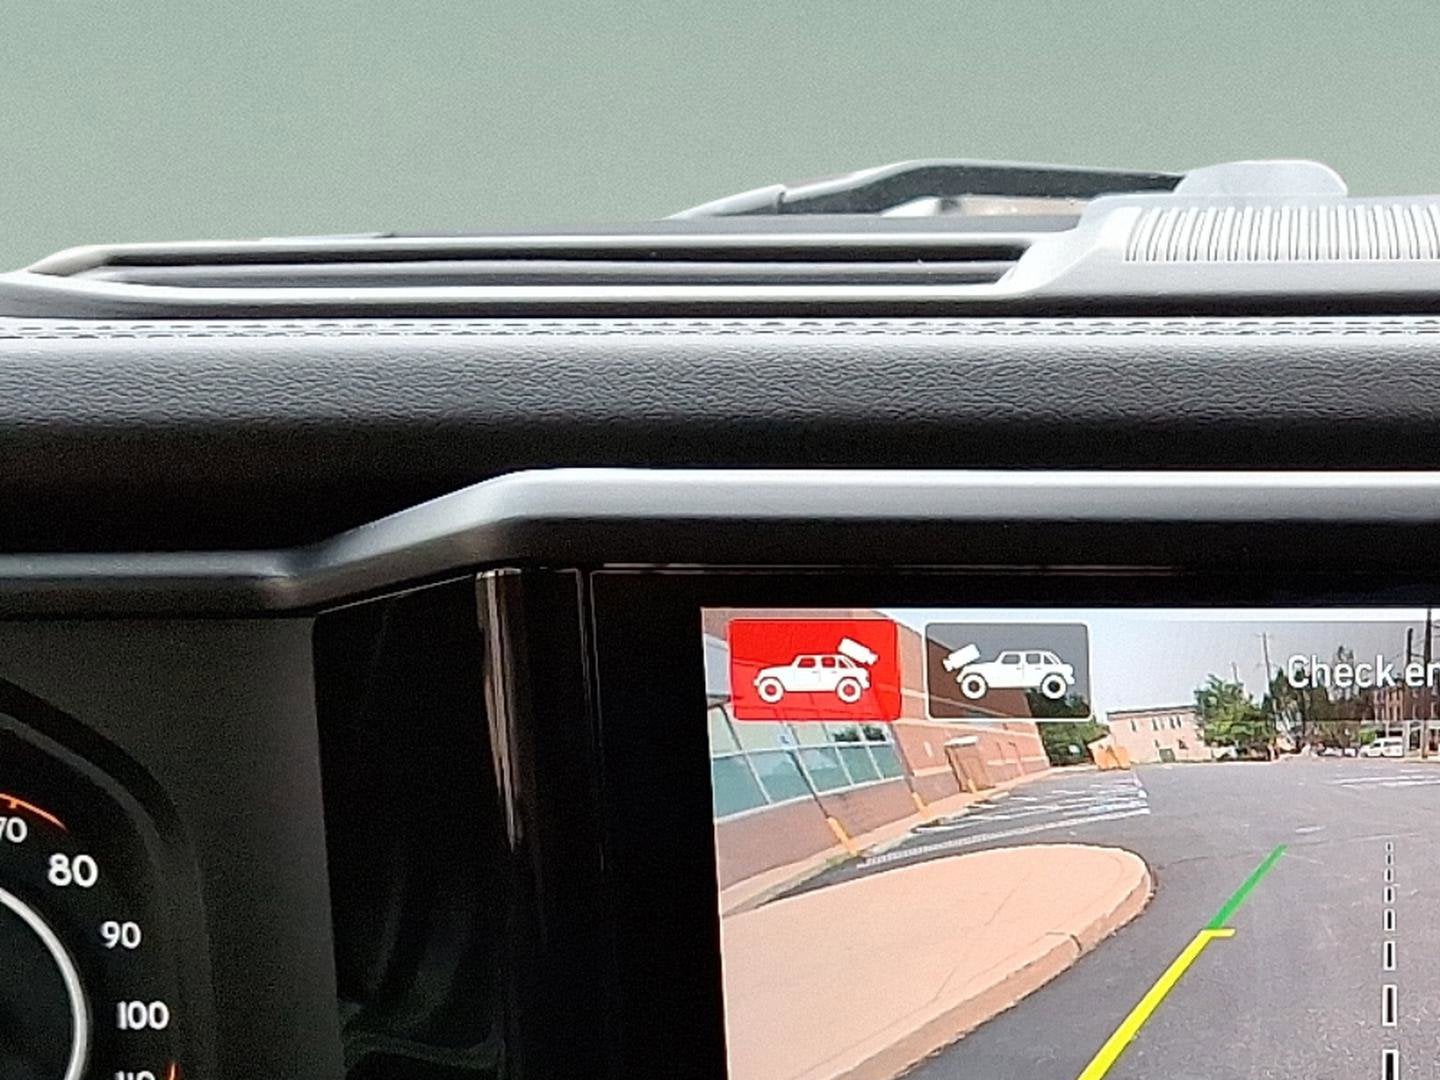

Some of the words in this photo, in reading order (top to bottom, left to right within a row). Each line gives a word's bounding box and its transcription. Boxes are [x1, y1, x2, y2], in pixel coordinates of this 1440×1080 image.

[1287, 654, 1397, 688] Check
[47, 853, 99, 888] 80
[100, 921, 142, 950] 90
[115, 1001, 170, 1031] 100
